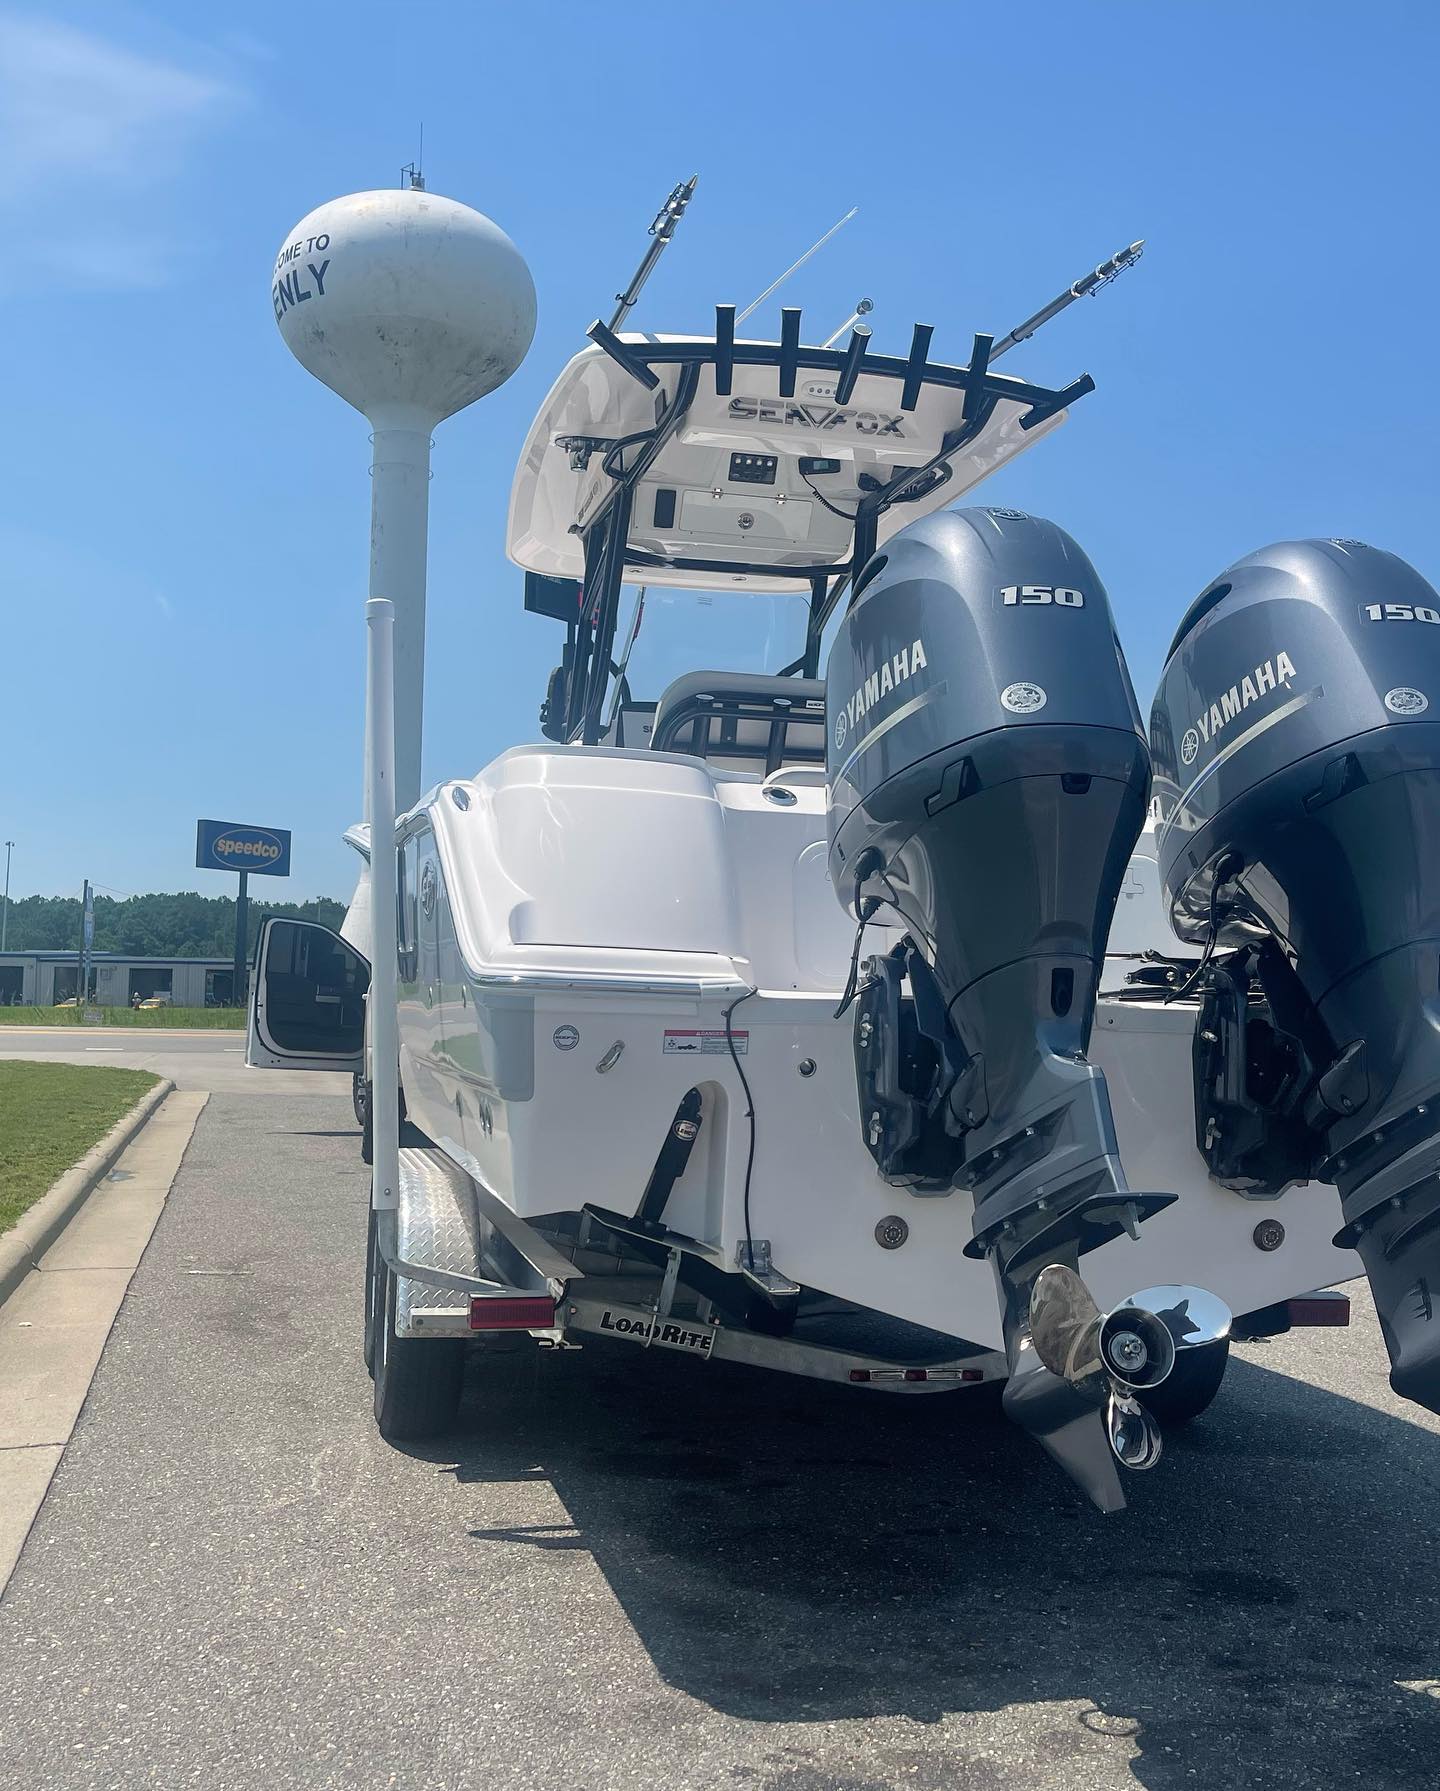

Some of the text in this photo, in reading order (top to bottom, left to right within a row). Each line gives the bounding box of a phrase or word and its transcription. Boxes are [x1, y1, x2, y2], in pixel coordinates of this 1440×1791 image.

[275, 233, 330, 272] OME TO
[1000, 585, 1084, 608] 150
[1365, 604, 1440, 625] 150
[846, 639, 928, 731] YAMAHA
[1197, 651, 1297, 744] YAMAHA
[217, 839, 279, 859] speedco
